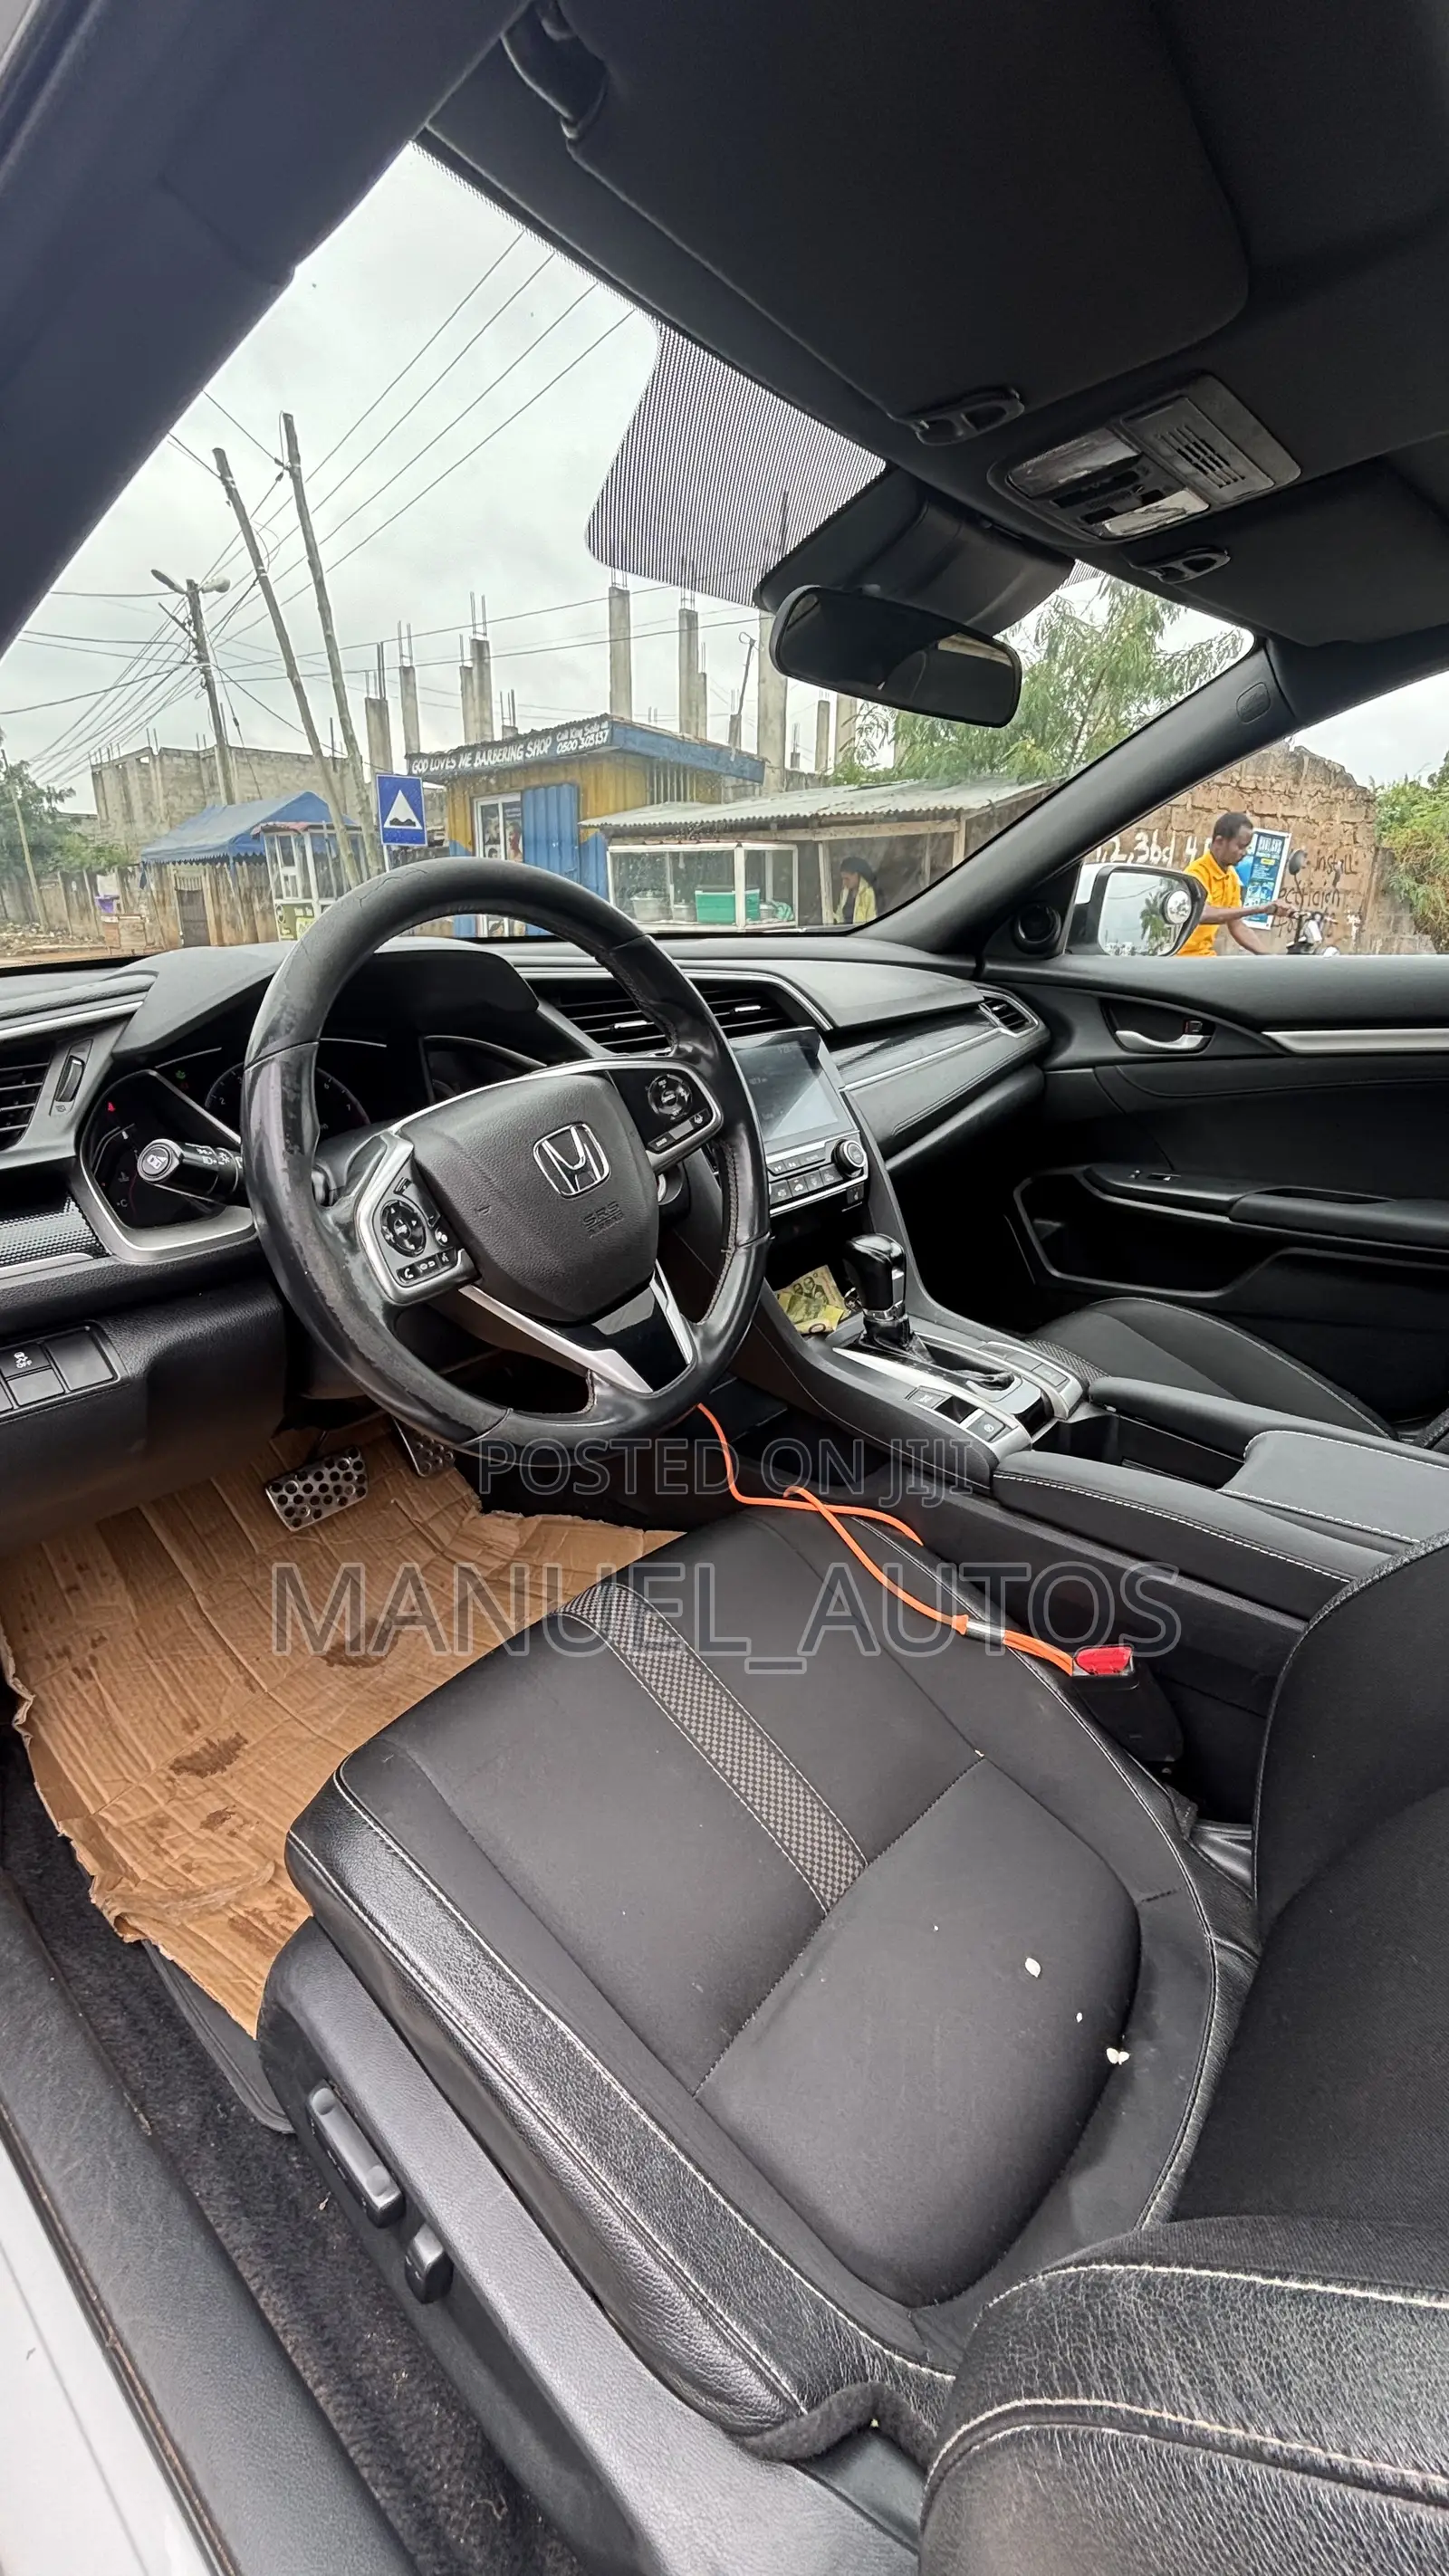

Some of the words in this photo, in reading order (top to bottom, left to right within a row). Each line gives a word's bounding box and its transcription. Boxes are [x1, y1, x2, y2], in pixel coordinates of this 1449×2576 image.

[412, 758, 428, 774] GOD
[429, 757, 456, 772] LOVES
[458, 752, 472, 769] ME
[474, 743, 524, 767] BARBERING
[525, 735, 552, 759] SHOP
[582, 1201, 619, 1229] SRS
